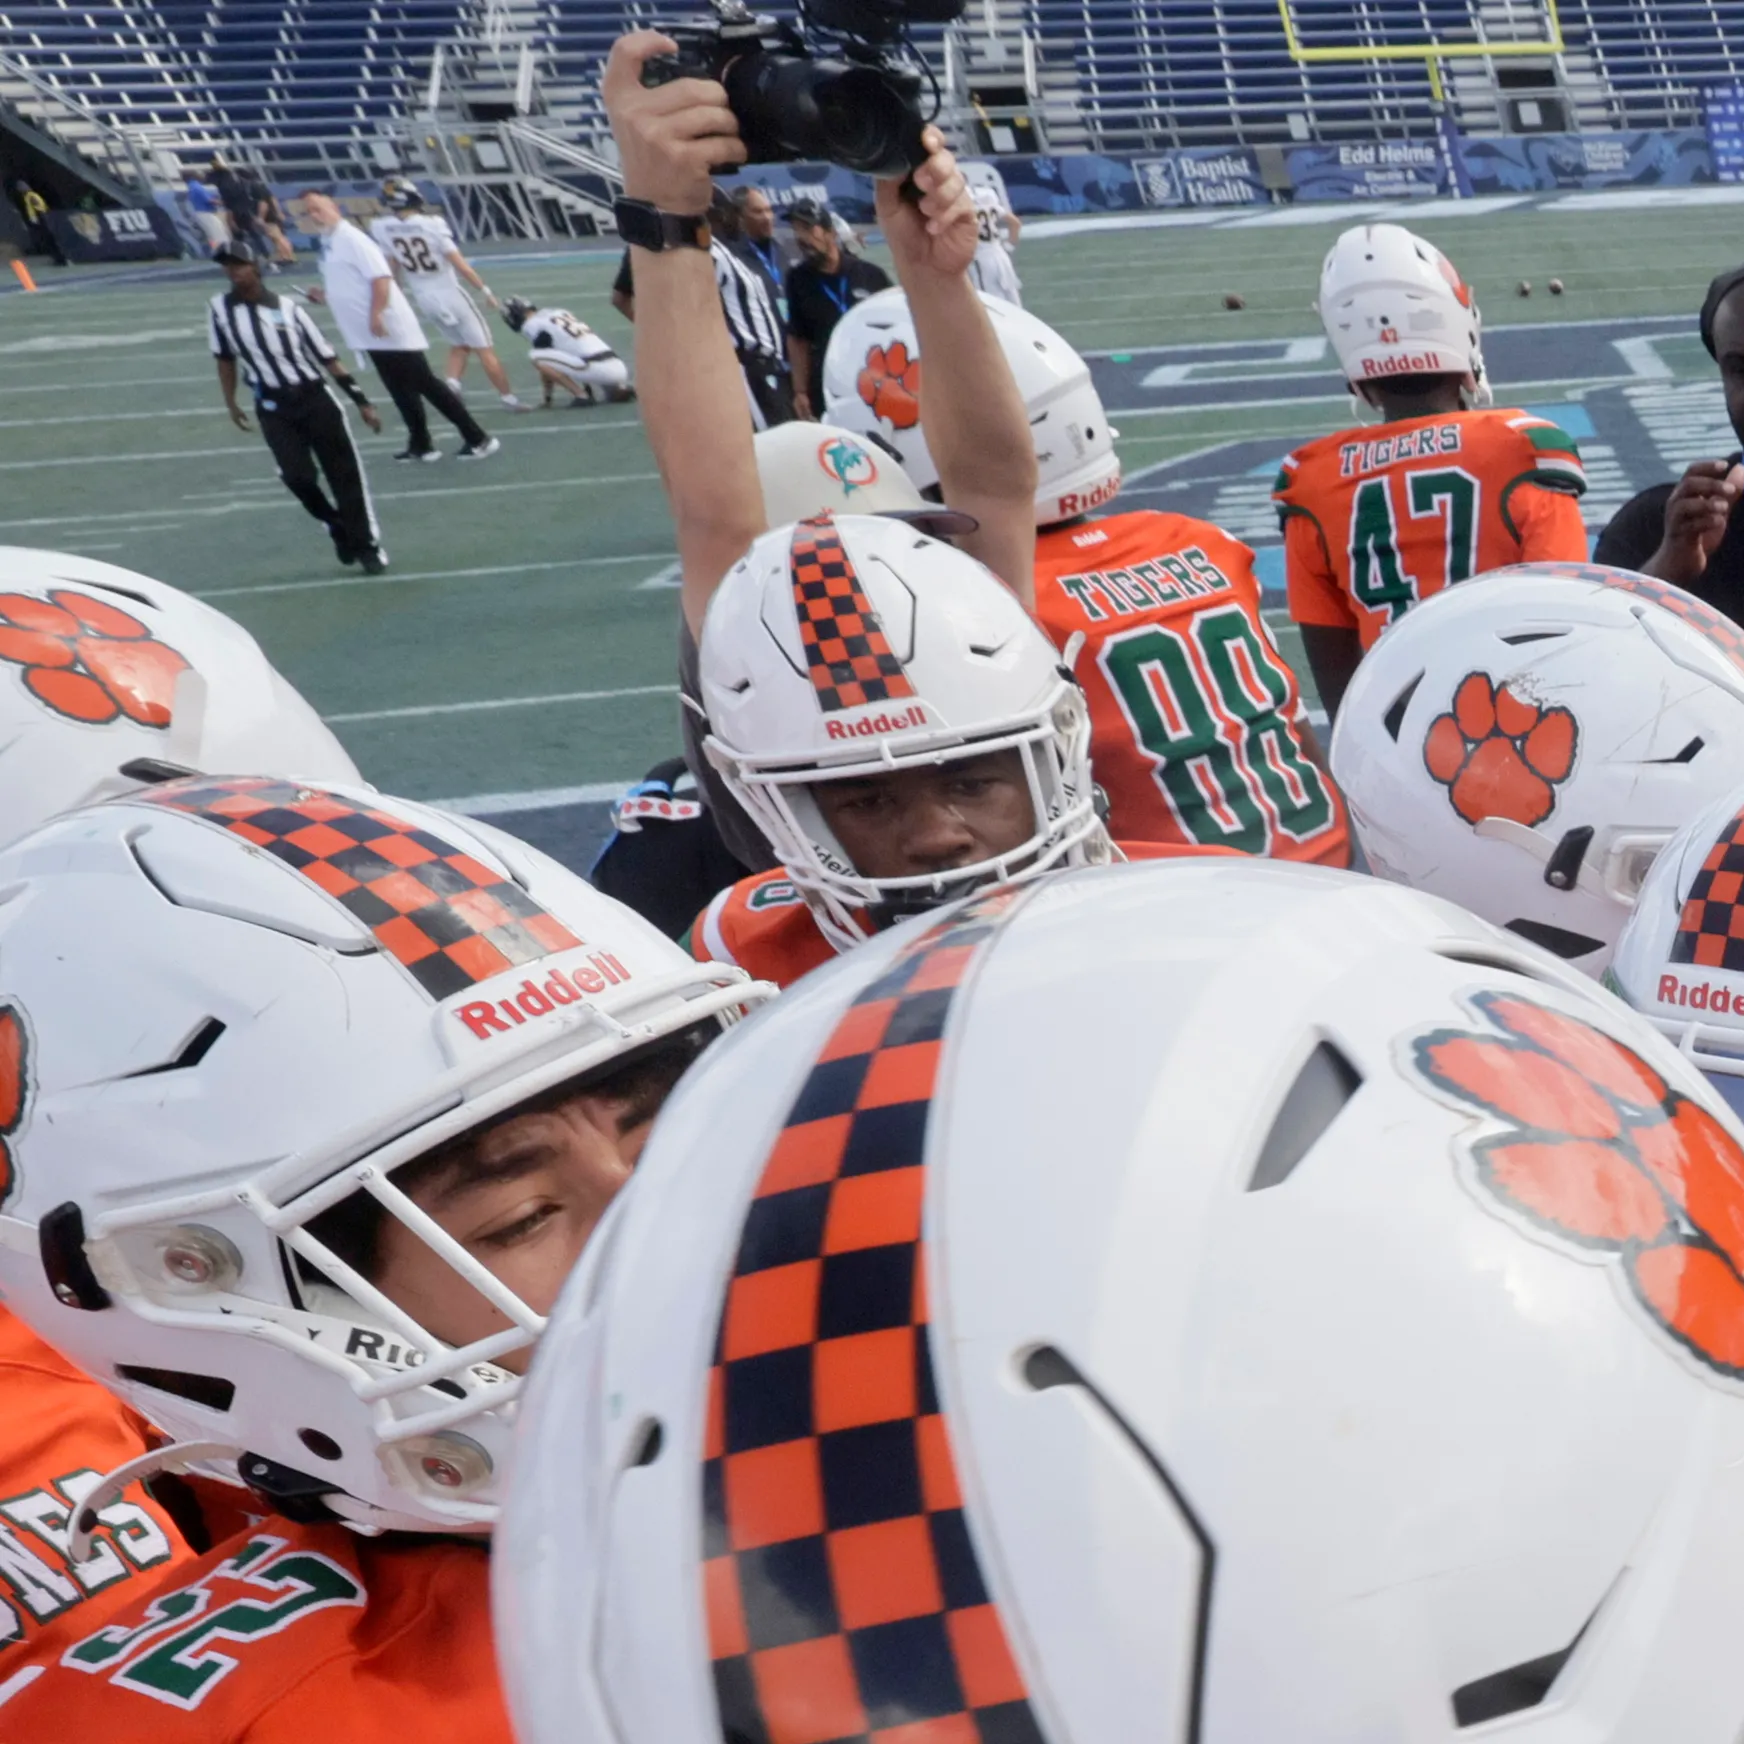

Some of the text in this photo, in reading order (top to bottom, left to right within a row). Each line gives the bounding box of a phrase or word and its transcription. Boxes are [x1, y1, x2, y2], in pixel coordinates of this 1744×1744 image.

[1180, 156, 1250, 180] Baptist
[1340, 145, 1435, 164] Edd Helms
[1186, 180, 1253, 203] Health
[104, 208, 151, 233] FIU
[393, 236, 439, 273] 32
[1379, 328, 1399, 344] 47
[1361, 352, 1440, 378] Riddell
[1340, 424, 1462, 477] TIGERS
[1347, 465, 1481, 628] 47
[1057, 546, 1232, 620] TIGERS
[825, 706, 928, 741] Riddell
[455, 948, 632, 1041] Riddell
